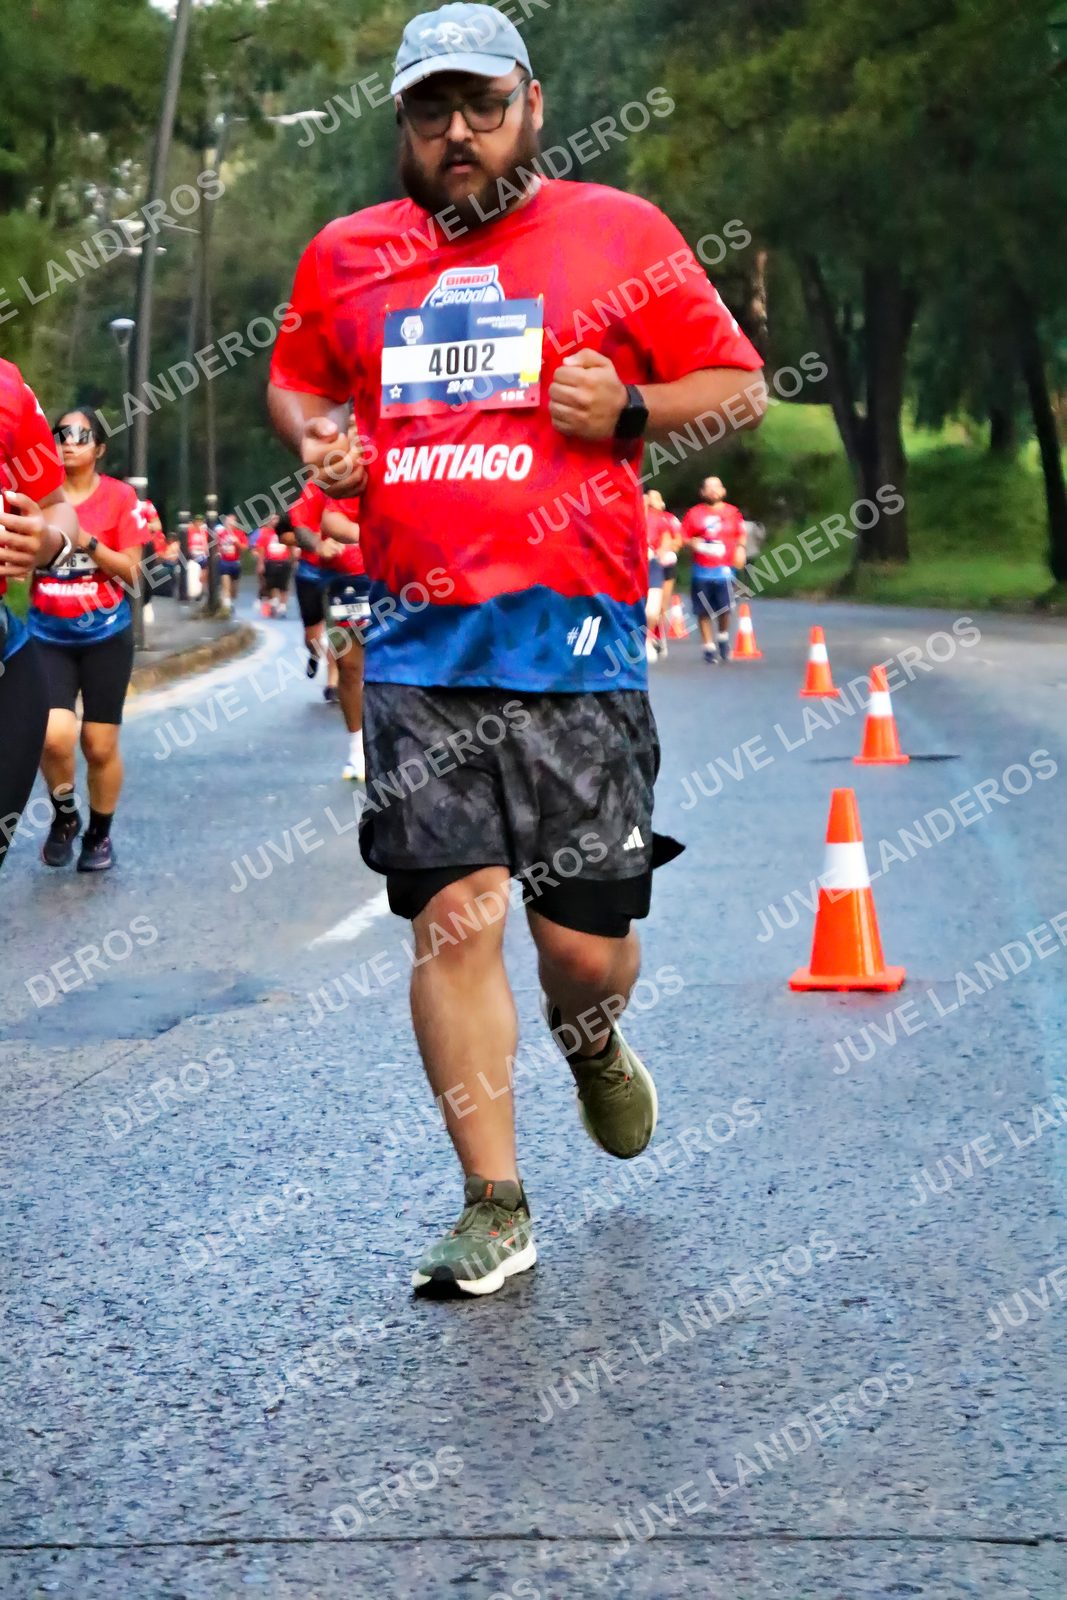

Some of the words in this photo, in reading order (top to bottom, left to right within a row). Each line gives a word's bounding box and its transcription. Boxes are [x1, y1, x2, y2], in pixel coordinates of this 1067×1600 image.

[446, 274, 490, 286] BIMBO
[443, 287, 487, 305] Global
[428, 342, 496, 377] 4002
[384, 444, 533, 485] SANTIAGO
